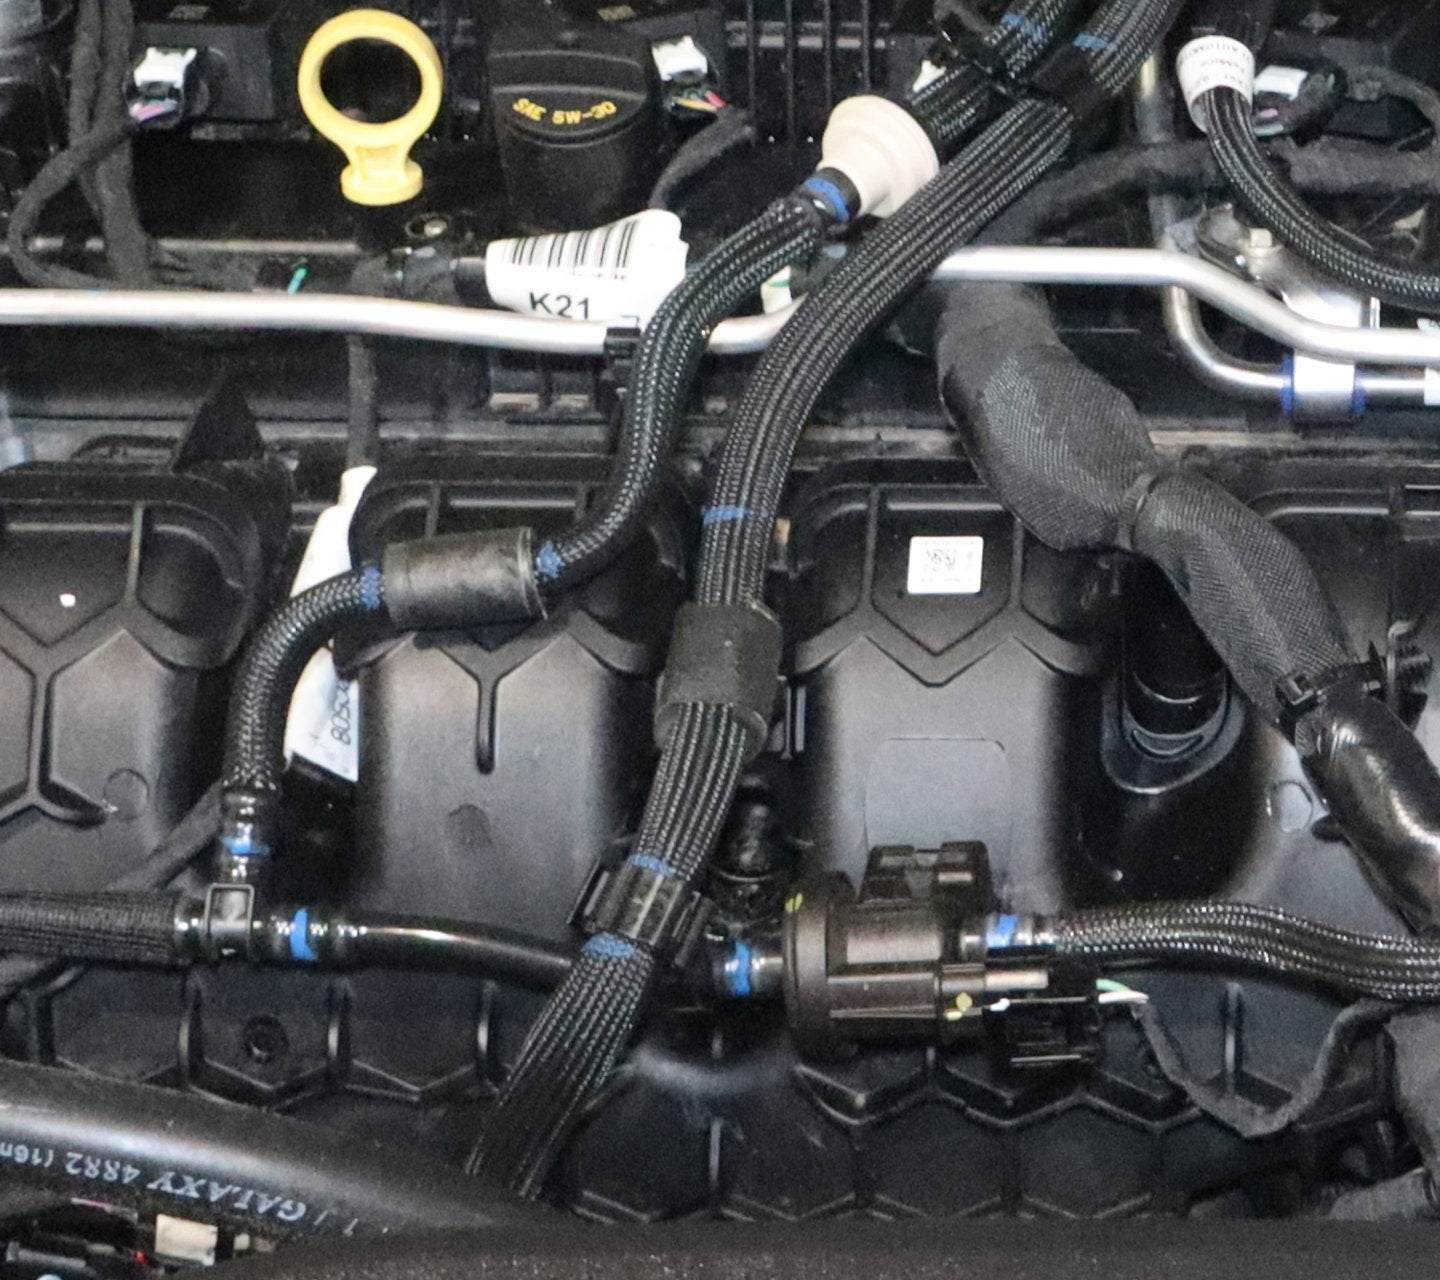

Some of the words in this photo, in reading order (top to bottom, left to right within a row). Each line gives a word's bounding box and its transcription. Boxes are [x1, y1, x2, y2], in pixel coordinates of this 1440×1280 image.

[512, 98, 547, 121] SAE
[552, 101, 617, 125] 5W-30
[529, 291, 589, 320] K21
[66, 1150, 142, 1187] 4882
[146, 1169, 309, 1224] GALAXY
